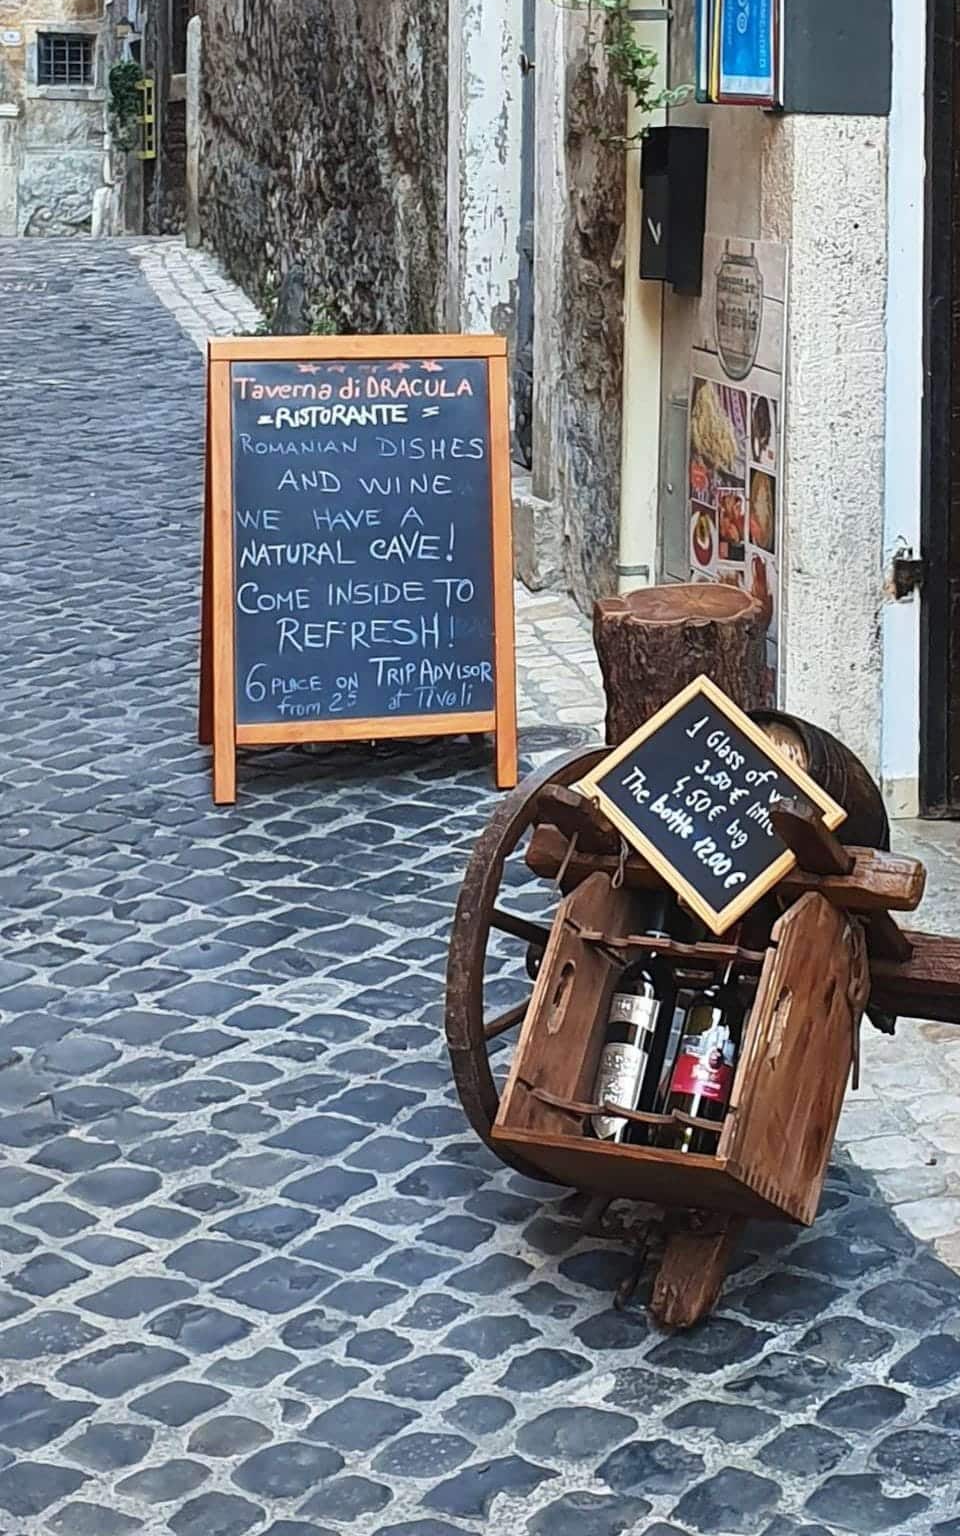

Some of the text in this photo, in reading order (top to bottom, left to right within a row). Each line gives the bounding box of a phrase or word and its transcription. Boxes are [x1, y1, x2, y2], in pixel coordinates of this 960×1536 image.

[233, 374, 473, 400] Taverna di DRACULA
[375, 436, 484, 460] DISHES
[276, 468, 453, 495] AND WINE
[236, 505, 425, 532] WE HAVE A
[239, 538, 357, 569] NATURAL
[328, 578, 428, 606] INSIDE
[432, 578, 475, 609] TO
[245, 662, 268, 703] 6
[270, 674, 324, 697] PLACE
[335, 671, 360, 692] ON
[276, 694, 322, 716] from
[387, 687, 413, 711] at
[413, 681, 474, 709] Tivoli
[685, 715, 779, 788] 1 Glass of
[620, 764, 651, 804] The
[648, 792, 695, 840] bottle
[725, 817, 750, 850] big
